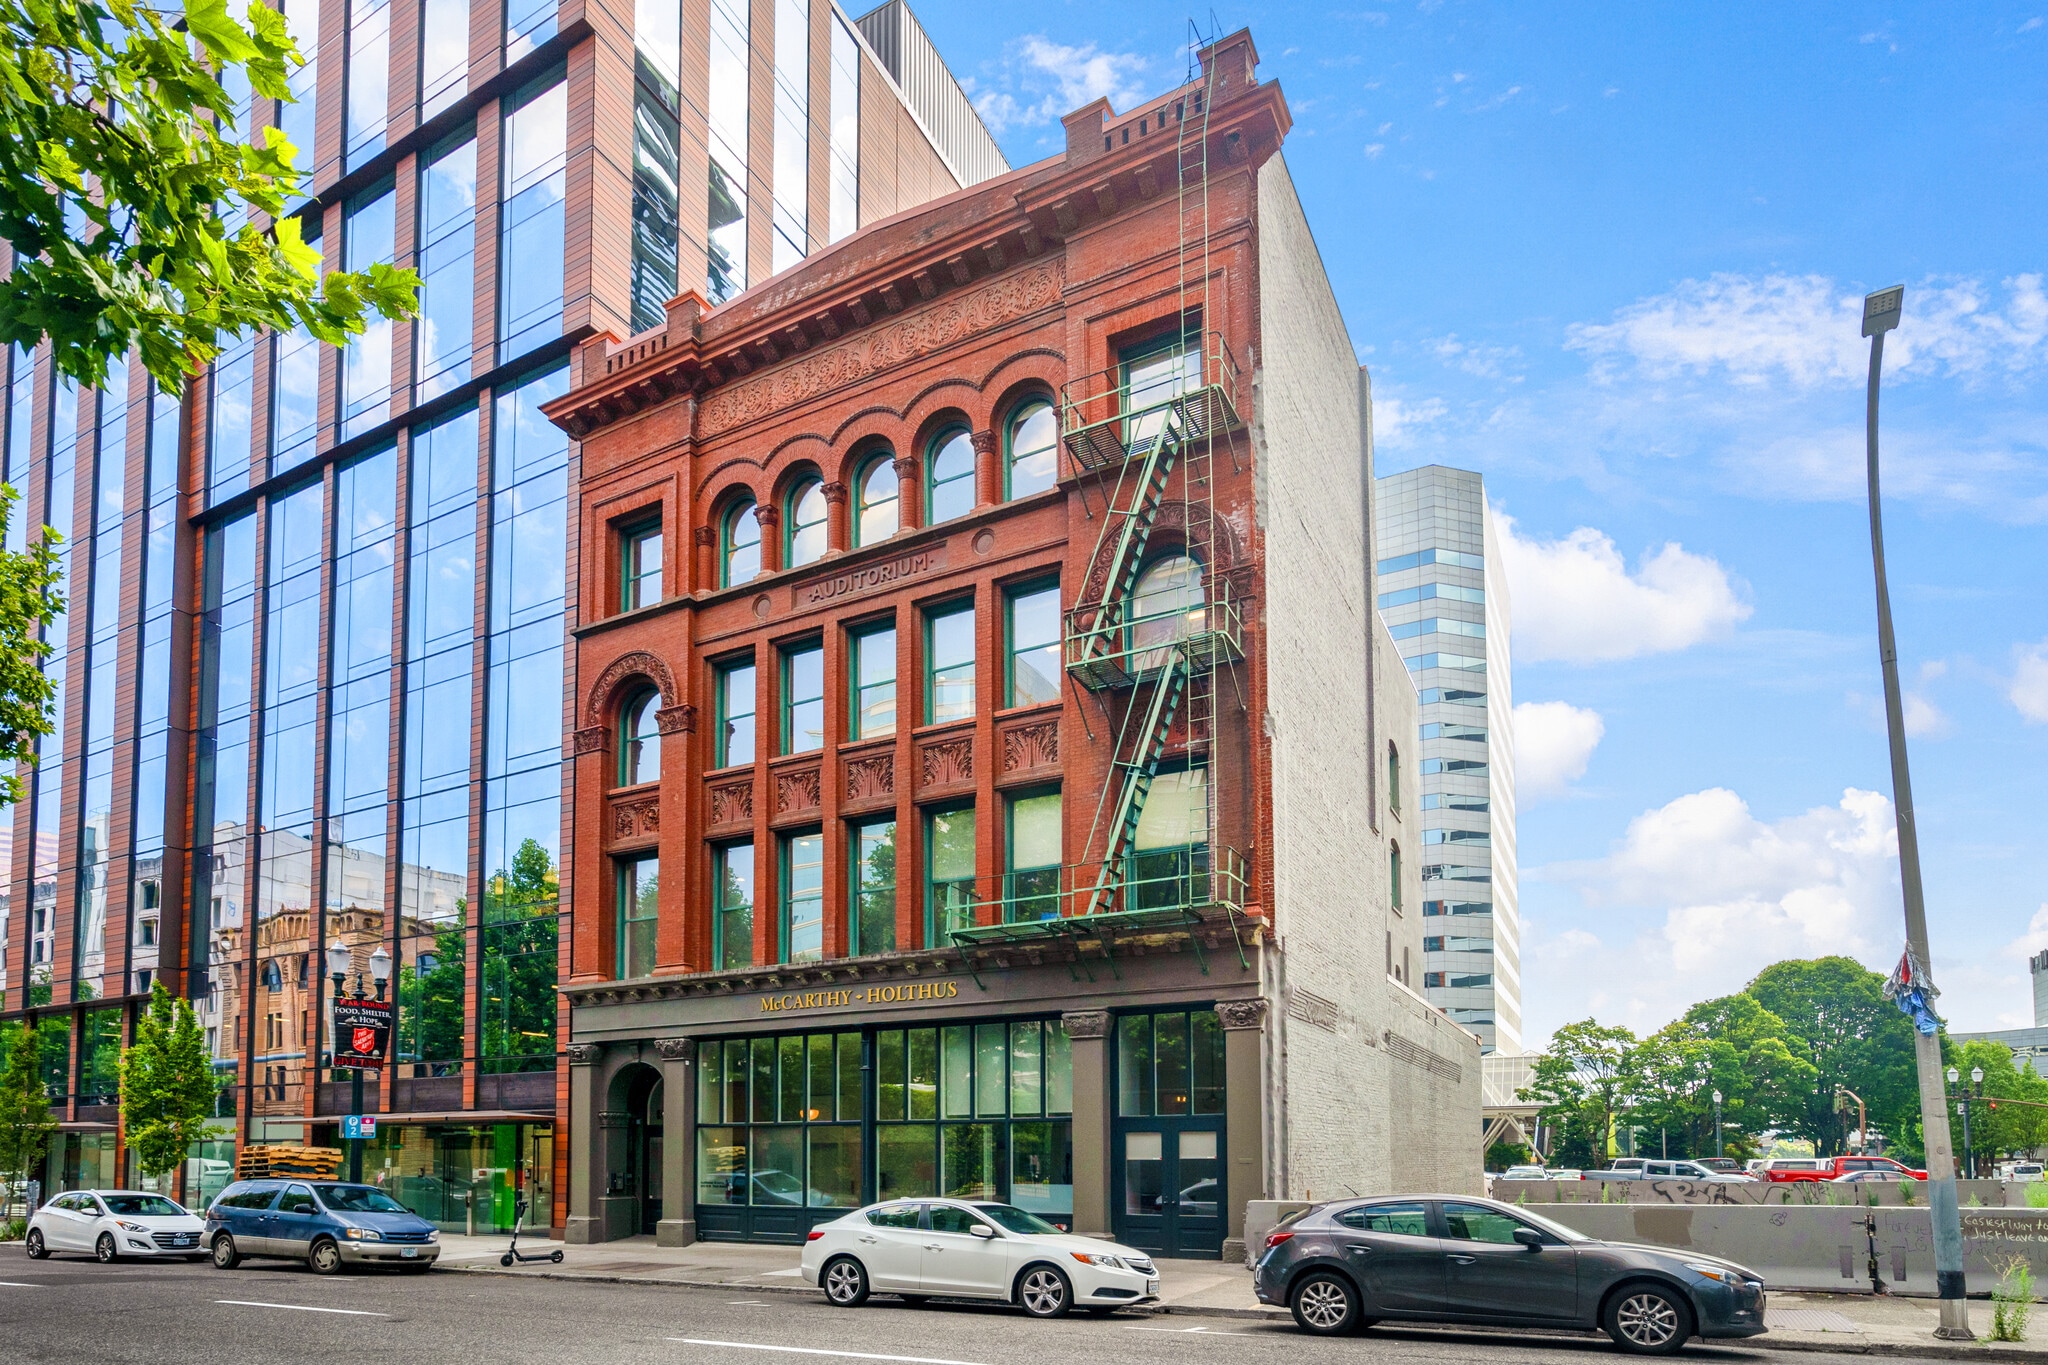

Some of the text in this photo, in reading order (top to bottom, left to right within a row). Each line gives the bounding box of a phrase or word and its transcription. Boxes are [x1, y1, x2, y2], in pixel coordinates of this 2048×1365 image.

[811, 553, 929, 602] AUDITORIUM
[760, 981, 958, 1012] McCARTHY HOLTHUS
[334, 1057, 356, 1066] GIVE
[350, 1126, 357, 1136] 2
